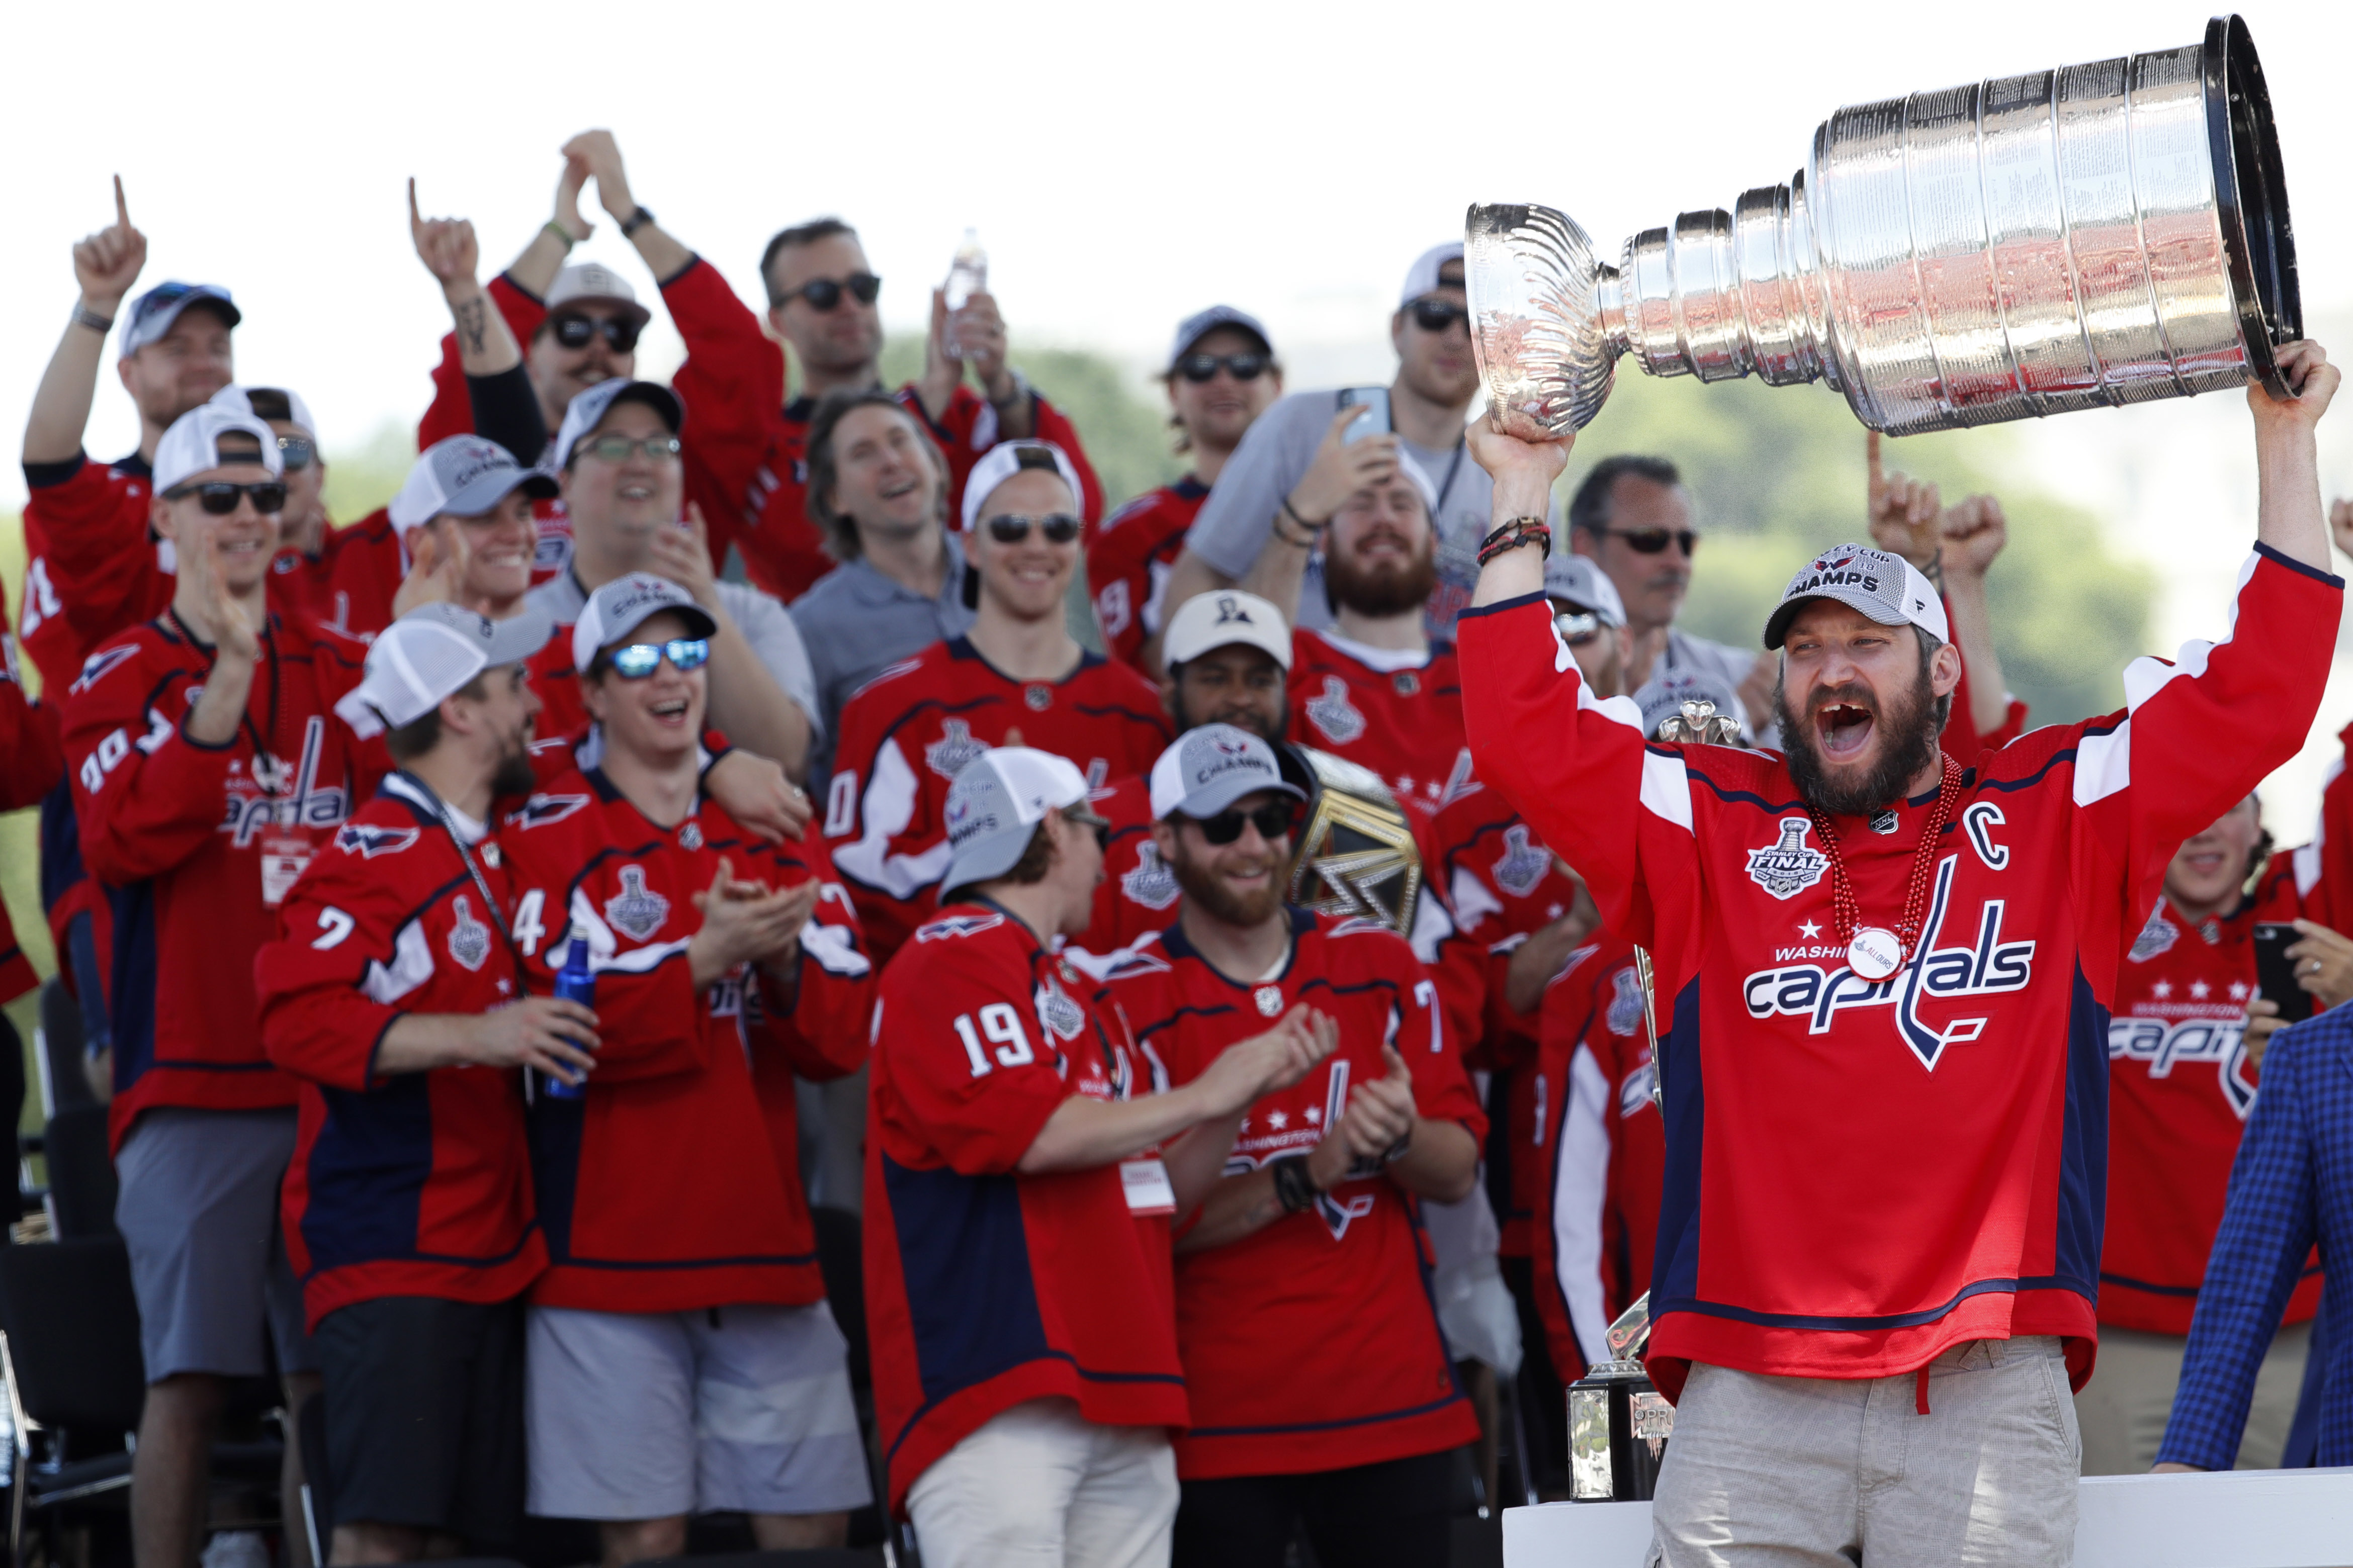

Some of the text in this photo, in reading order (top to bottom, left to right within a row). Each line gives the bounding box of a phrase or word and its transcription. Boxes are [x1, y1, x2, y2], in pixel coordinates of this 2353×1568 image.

[1860, 549, 1889, 563] CUP
[1875, 815, 1893, 829] NHL
[1963, 801, 2010, 871] C
[1754, 856, 1820, 870] FINAL
[1866, 947, 1894, 970] ALL OURS
[1414, 979, 1442, 1053] 7
[953, 1002, 1035, 1078] 19
